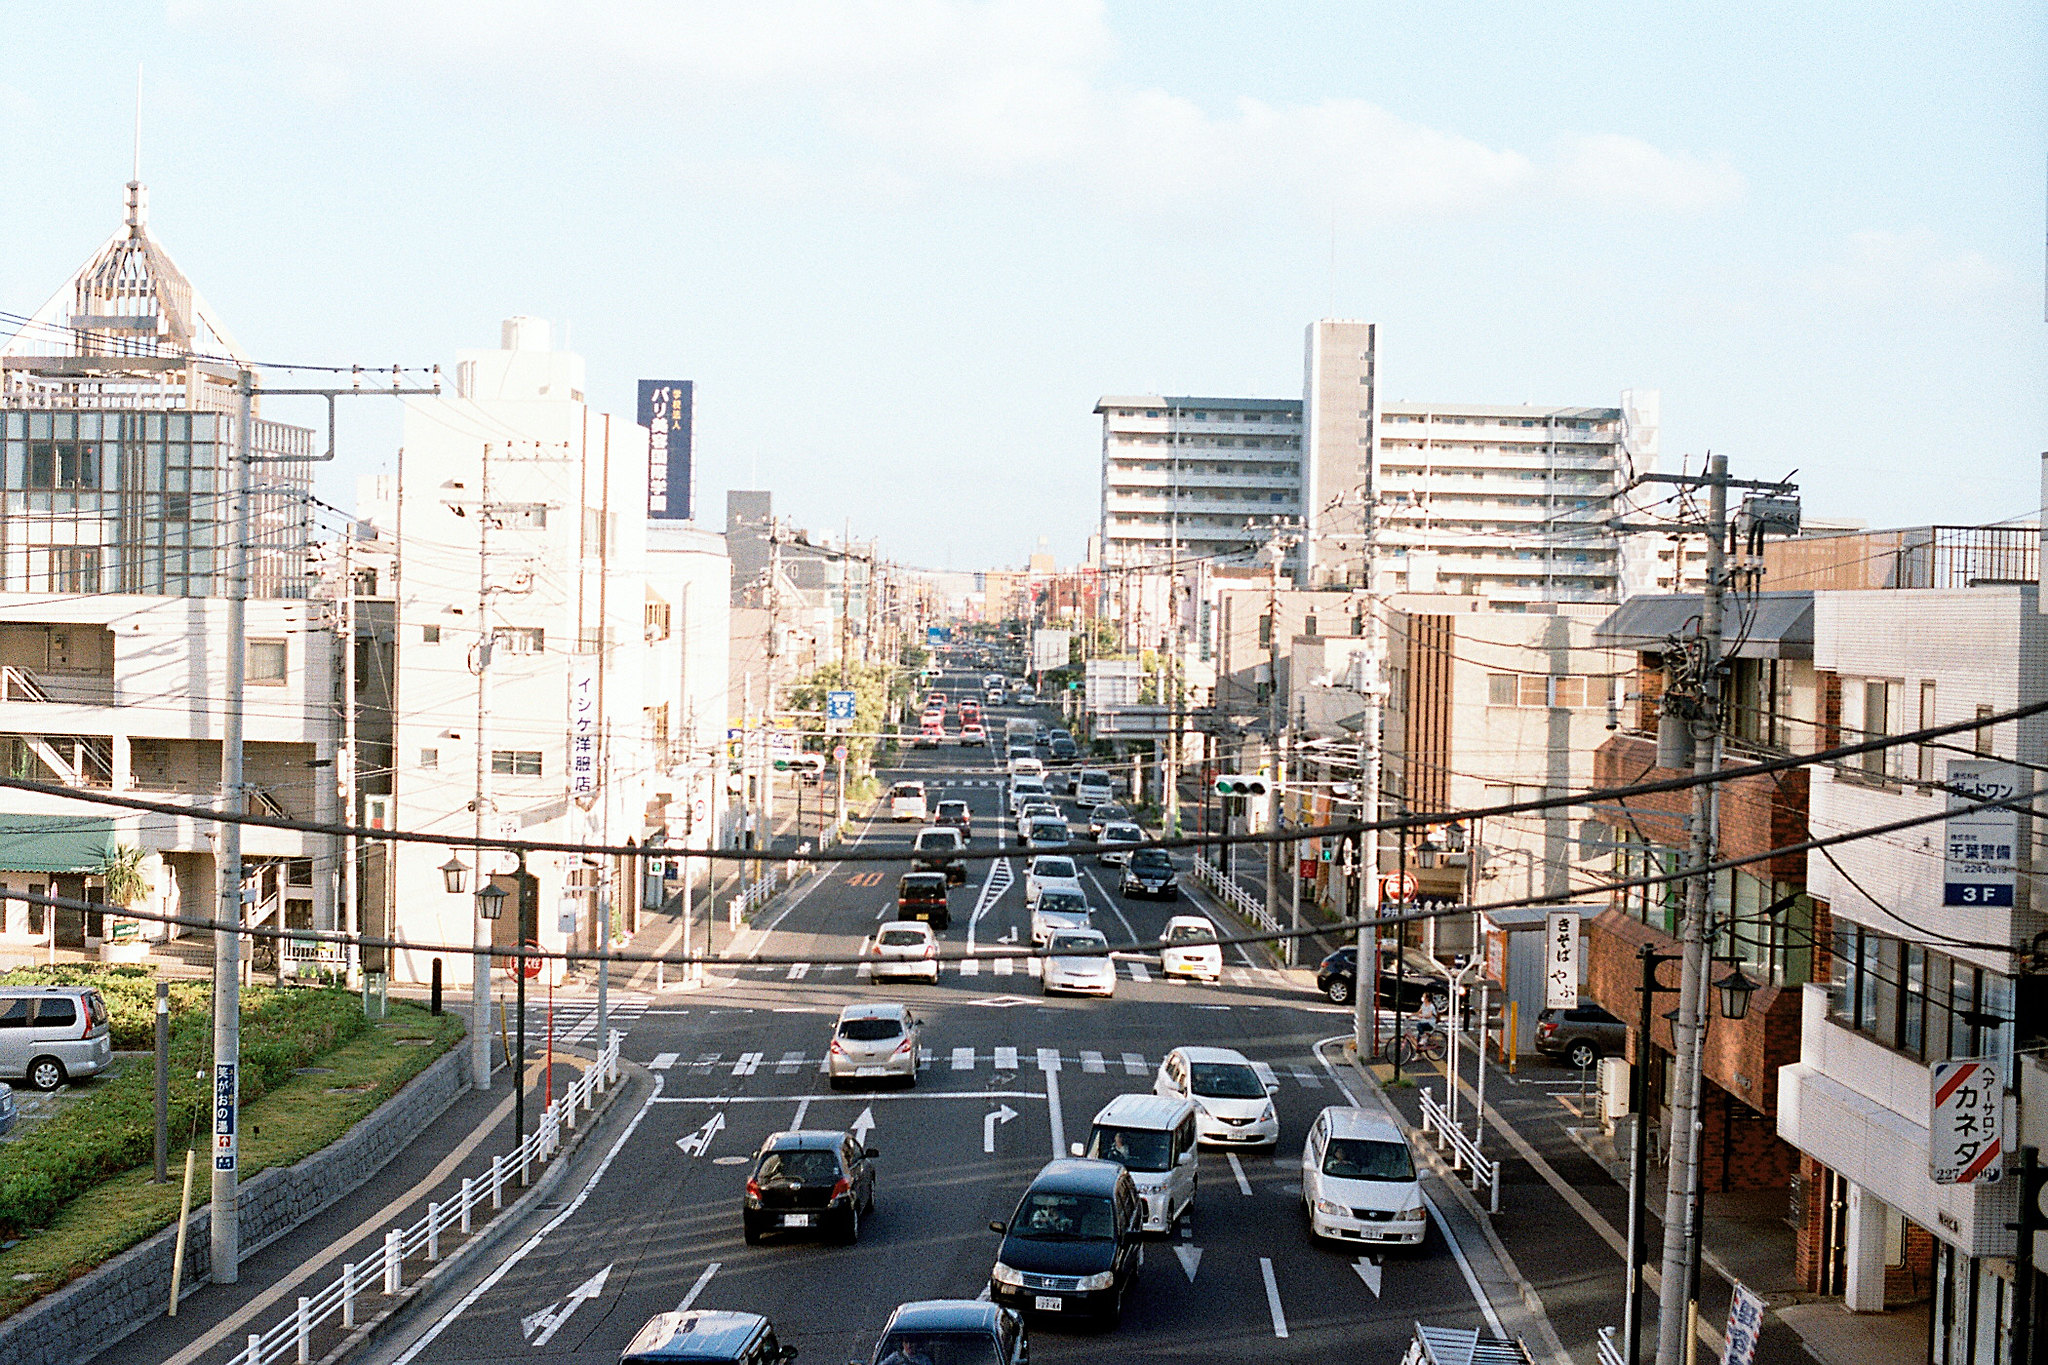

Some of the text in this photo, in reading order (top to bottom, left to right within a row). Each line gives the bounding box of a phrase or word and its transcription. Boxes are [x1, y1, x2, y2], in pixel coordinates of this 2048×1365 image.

[575, 678, 592, 792] イシケ洋服店
[844, 872, 884, 887] 40
[1949, 844, 2010, 859] 千葉警備
[217, 1066, 229, 1133] 笑がおの湯
[1954, 1085, 1980, 1166] カネダ
[1982, 1067, 1996, 1141] ヘアーサロン
